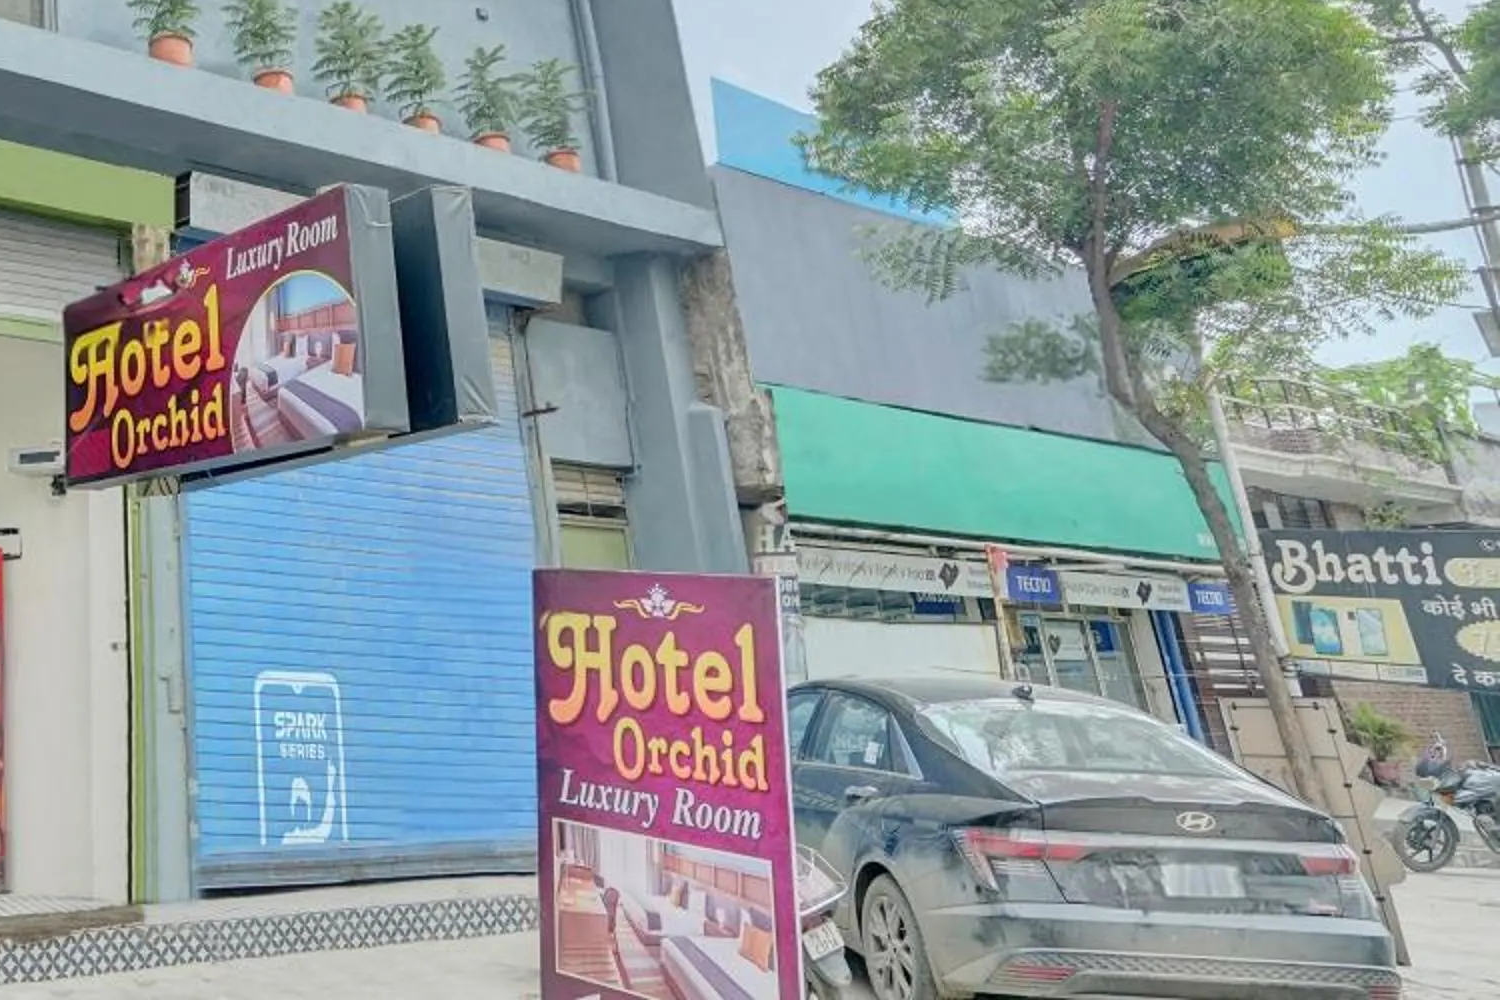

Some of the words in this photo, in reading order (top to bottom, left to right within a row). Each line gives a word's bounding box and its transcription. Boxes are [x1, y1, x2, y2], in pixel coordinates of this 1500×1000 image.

[225, 233, 284, 282] Luxury
[285, 212, 339, 255] Room
[69, 283, 226, 433] Hotel
[111, 381, 228, 470] Orchid
[1015, 574, 1053, 595] TECNO
[1271, 538, 1443, 594] Bhatti
[545, 610, 766, 725] Hotel
[273, 711, 328, 741] SPARK
[279, 743, 326, 760] SERIES
[613, 716, 769, 792] Orchid
[558, 768, 660, 829] Luxury
[671, 786, 763, 840] Room
